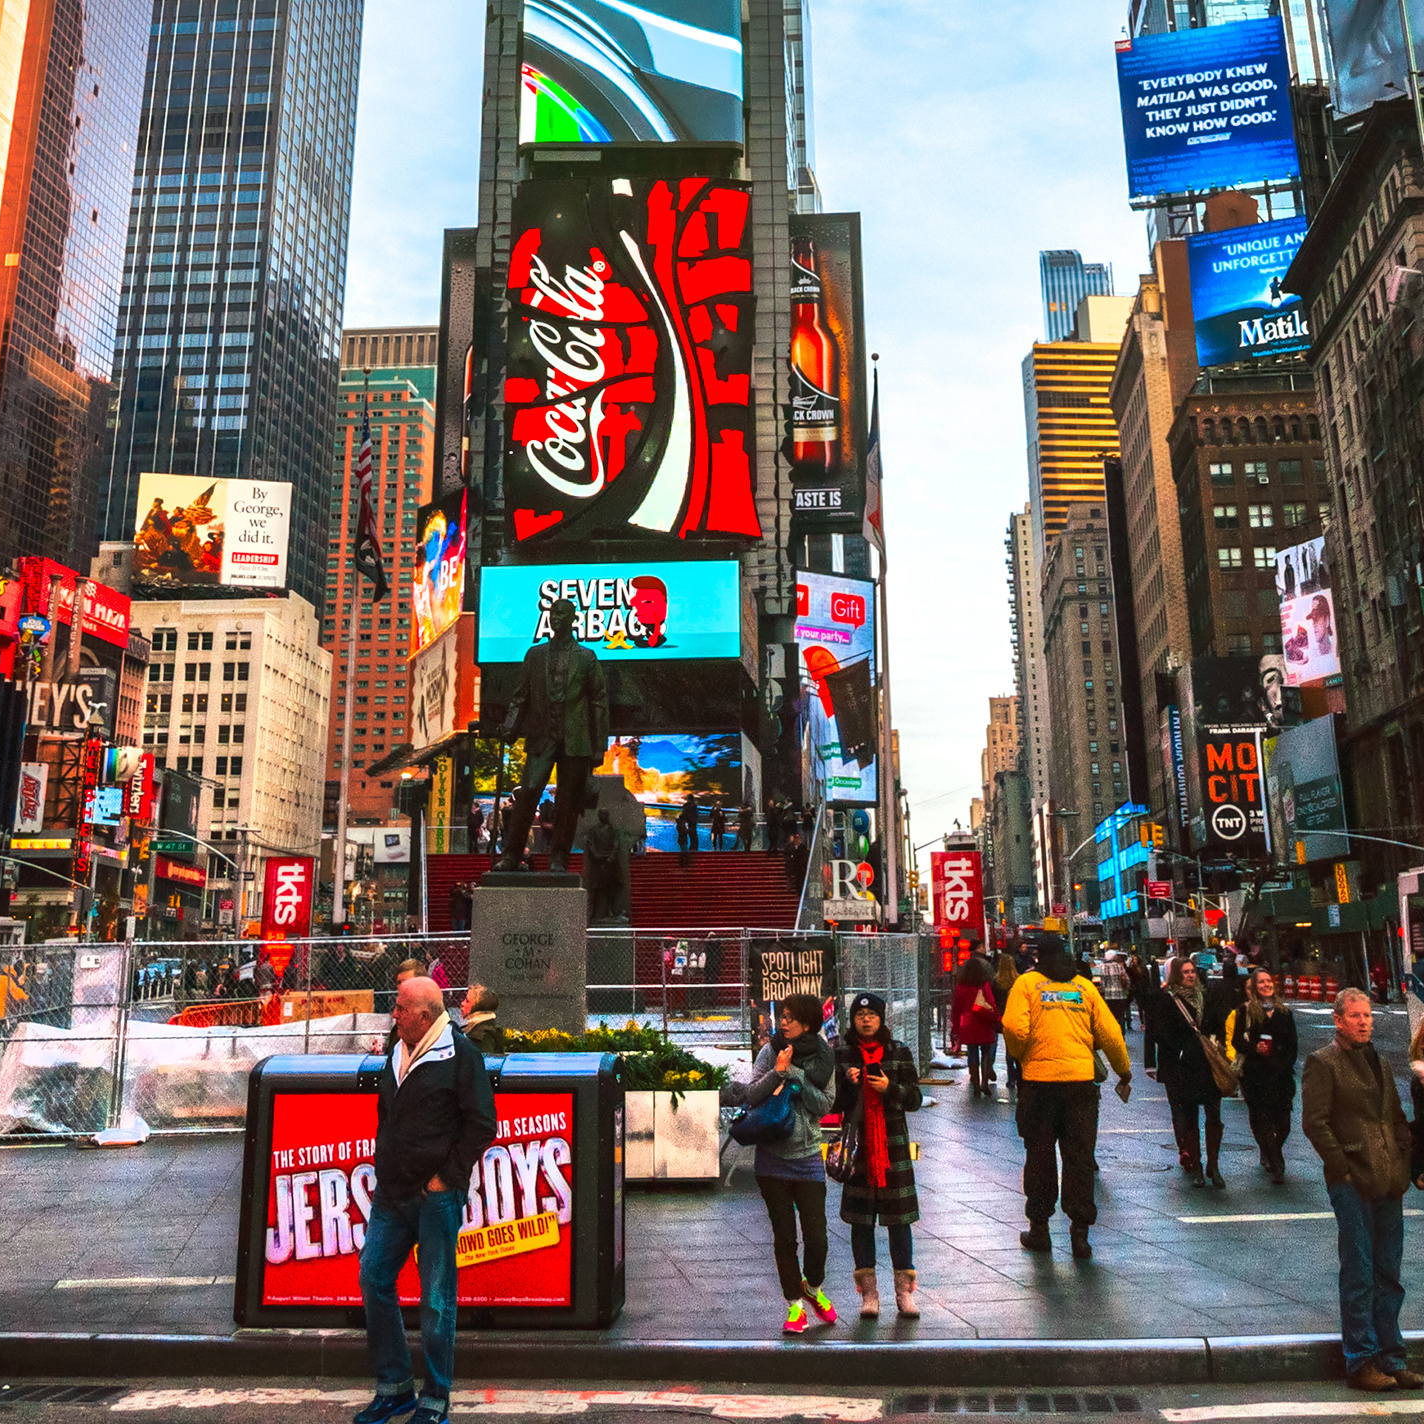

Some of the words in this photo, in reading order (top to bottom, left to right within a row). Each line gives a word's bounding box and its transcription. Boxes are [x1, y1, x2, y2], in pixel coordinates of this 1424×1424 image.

[1116, 42, 1131, 50] RSC
[1226, 63, 1267, 79] KNEW
[1137, 89, 1196, 108] MATILDA
[1198, 85, 1229, 98] WAS
[1231, 78, 1277, 94] GOOD,
[1145, 107, 1182, 122] THEY
[1185, 102, 1217, 117] JUST
[1220, 95, 1268, 112] DIDN'T
[1146, 123, 1189, 138] KNOW
[1193, 117, 1227, 132] HOW
[806, 409, 834, 420] CROWN
[252, 487, 268, 503] By
[830, 491, 841, 506] IS
[234, 500, 283, 518] George,
[249, 519, 267, 528] we
[238, 530, 259, 543] did
[262, 531, 274, 544] it.
[233, 554, 275, 564] LEADERSHIP
[441, 557, 457, 591] BE
[540, 578, 633, 609] SEVEN
[834, 597, 861, 620] Gift
[801, 629, 820, 641] your
[130, 759, 146, 815] Twizzlers
[1217, 817, 1241, 828] TNT
[830, 860, 867, 901] R
[943, 858, 974, 920] tkts
[274, 862, 306, 925] tkts
[502, 932, 554, 946] GEORGE
[505, 957, 551, 971] COHAN
[762, 951, 823, 975] SPOTLIGHT
[770, 971, 789, 981] ON
[763, 975, 823, 1002] BROADWAY
[514, 1112, 566, 1136] SEASONS
[274, 1150, 294, 1168] THE
[298, 1145, 334, 1166] STORY
[338, 1142, 352, 1160] OF
[487, 1224, 514, 1249] GOES
